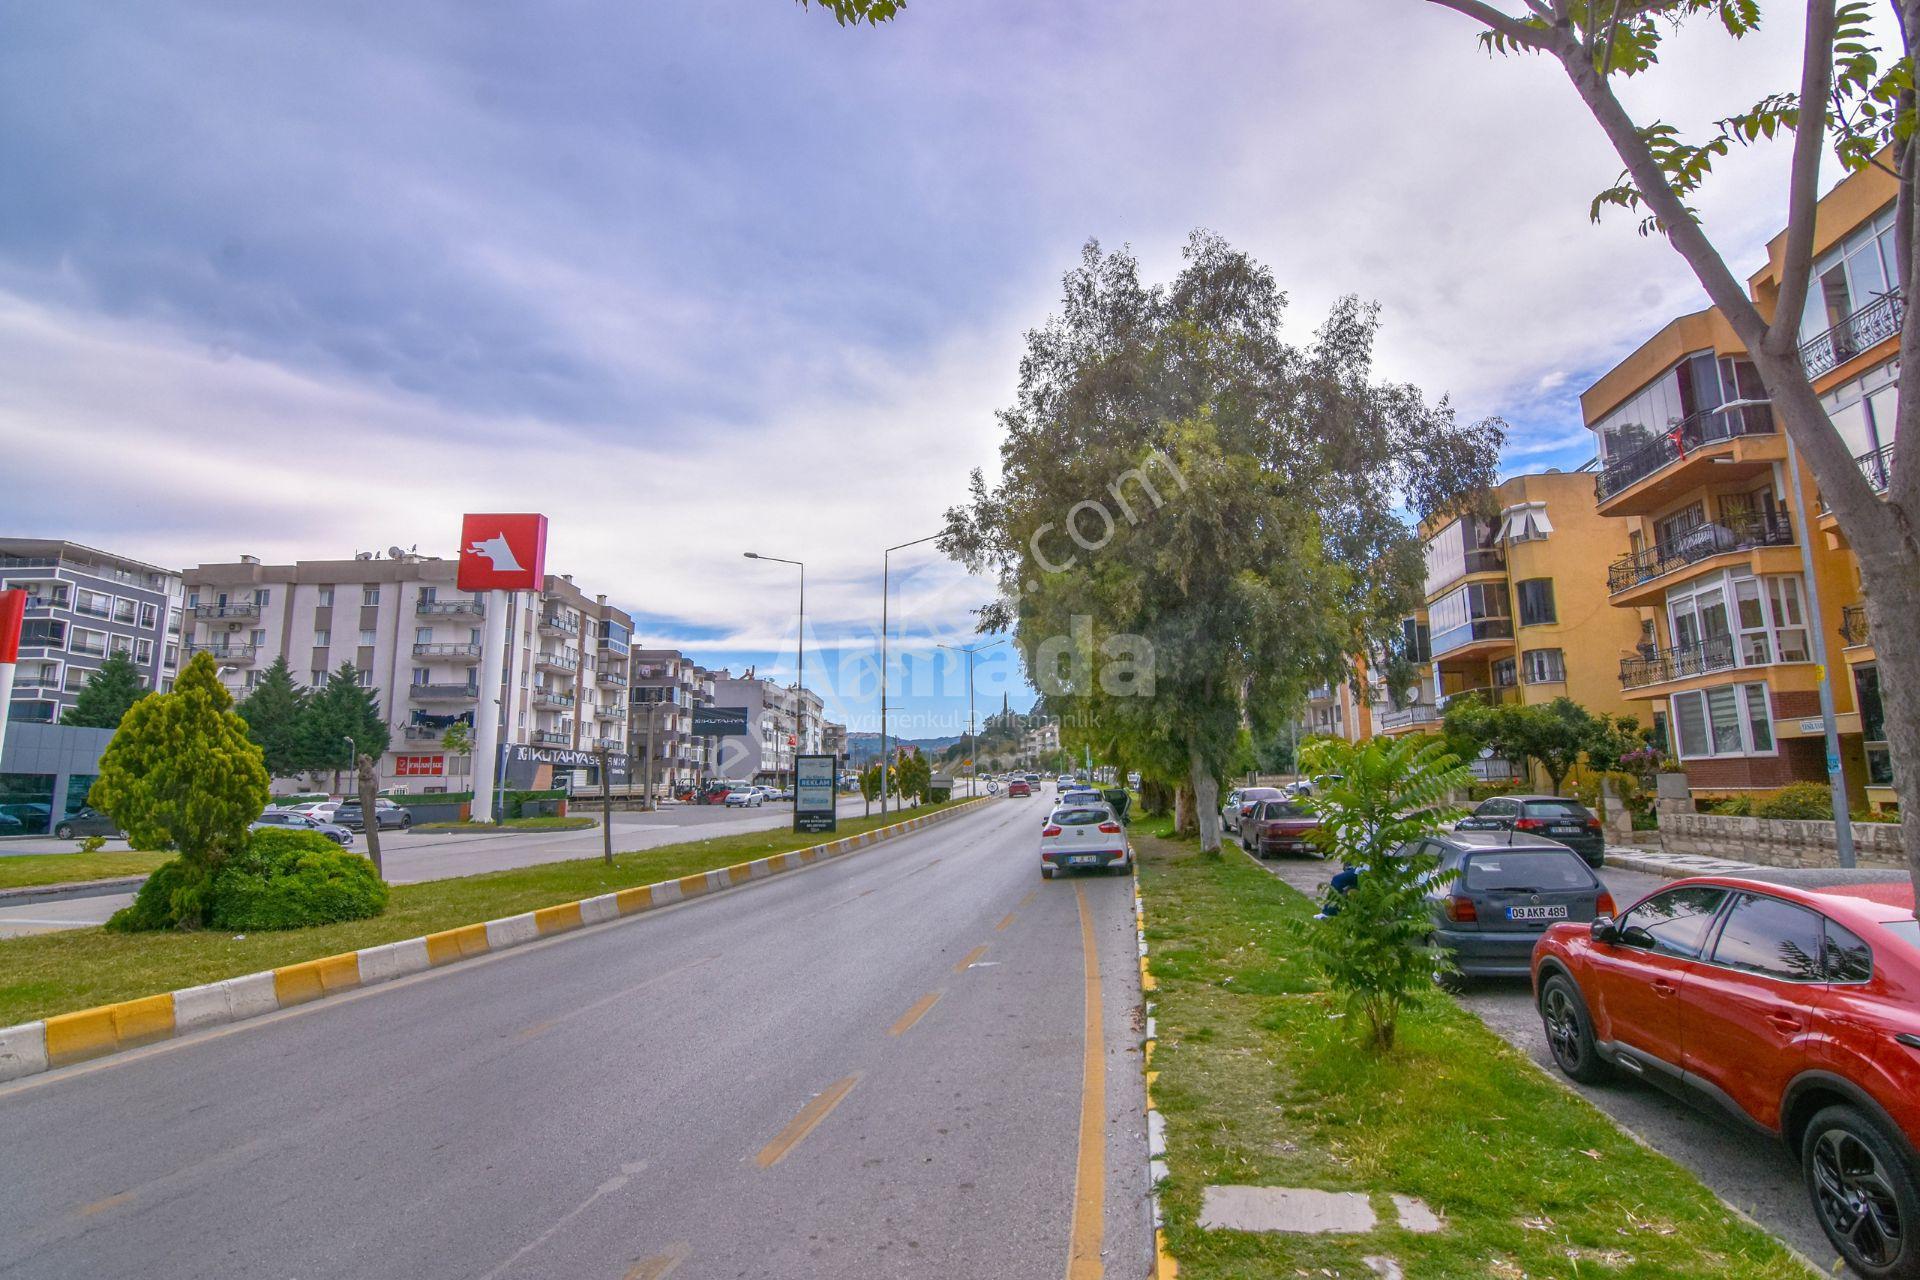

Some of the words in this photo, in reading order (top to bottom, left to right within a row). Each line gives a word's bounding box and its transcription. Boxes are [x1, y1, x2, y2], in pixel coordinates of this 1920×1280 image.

[1512, 908, 1525, 918] 09
[1527, 907, 1546, 918] AKR
[1547, 906, 1566, 917] 489
